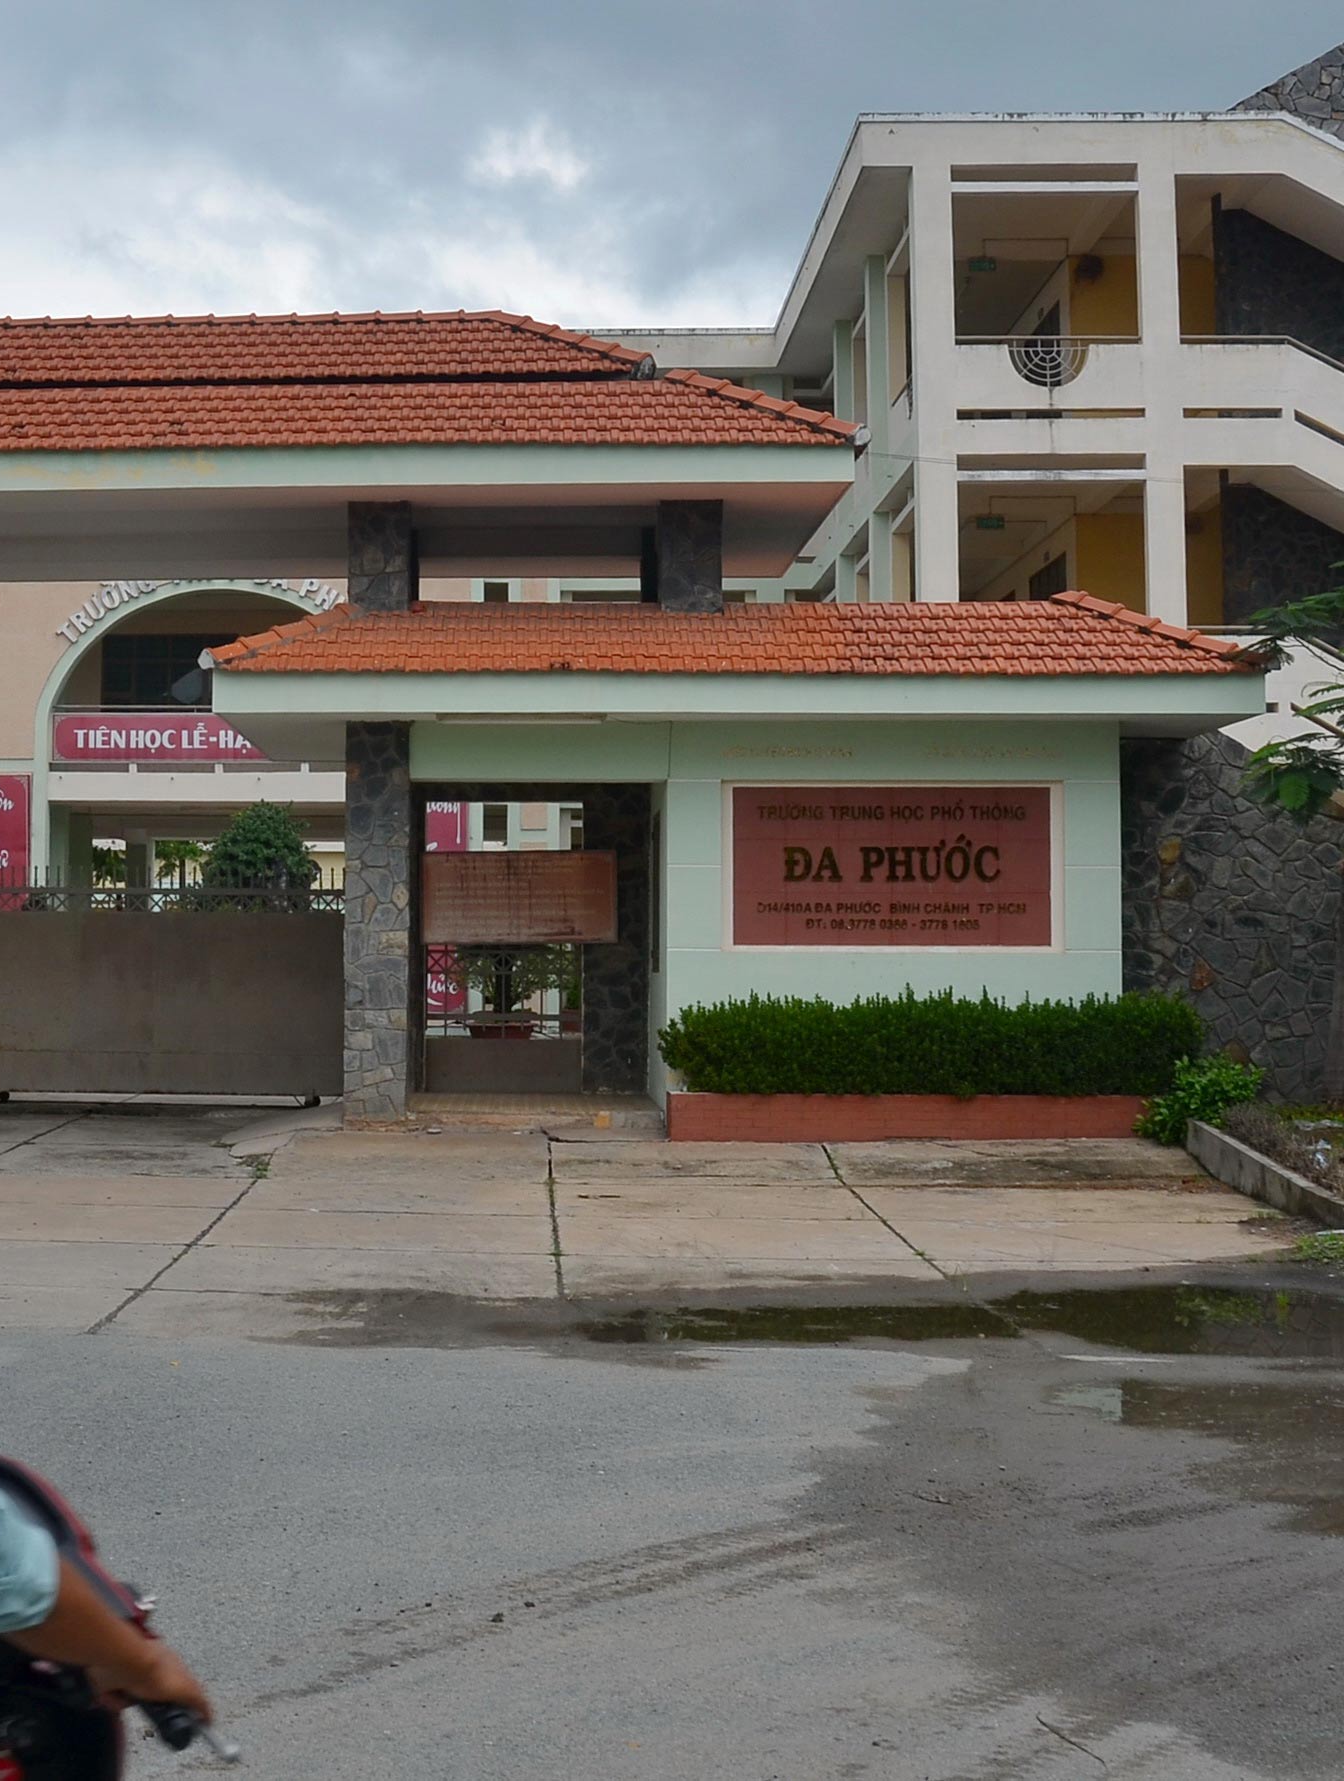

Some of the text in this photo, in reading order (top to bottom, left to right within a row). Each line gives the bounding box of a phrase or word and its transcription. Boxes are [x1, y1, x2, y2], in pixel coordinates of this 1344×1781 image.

[73, 726, 126, 749] TIÊN
[129, 729, 177, 754] HỌC
[829, 805, 886, 821] TRUNG
[889, 805, 926, 823] HỌC
[930, 799, 965, 821] PHỔ
[970, 802, 1026, 821] THÔNG
[783, 834, 1001, 884] ĐA PHƯỚC
